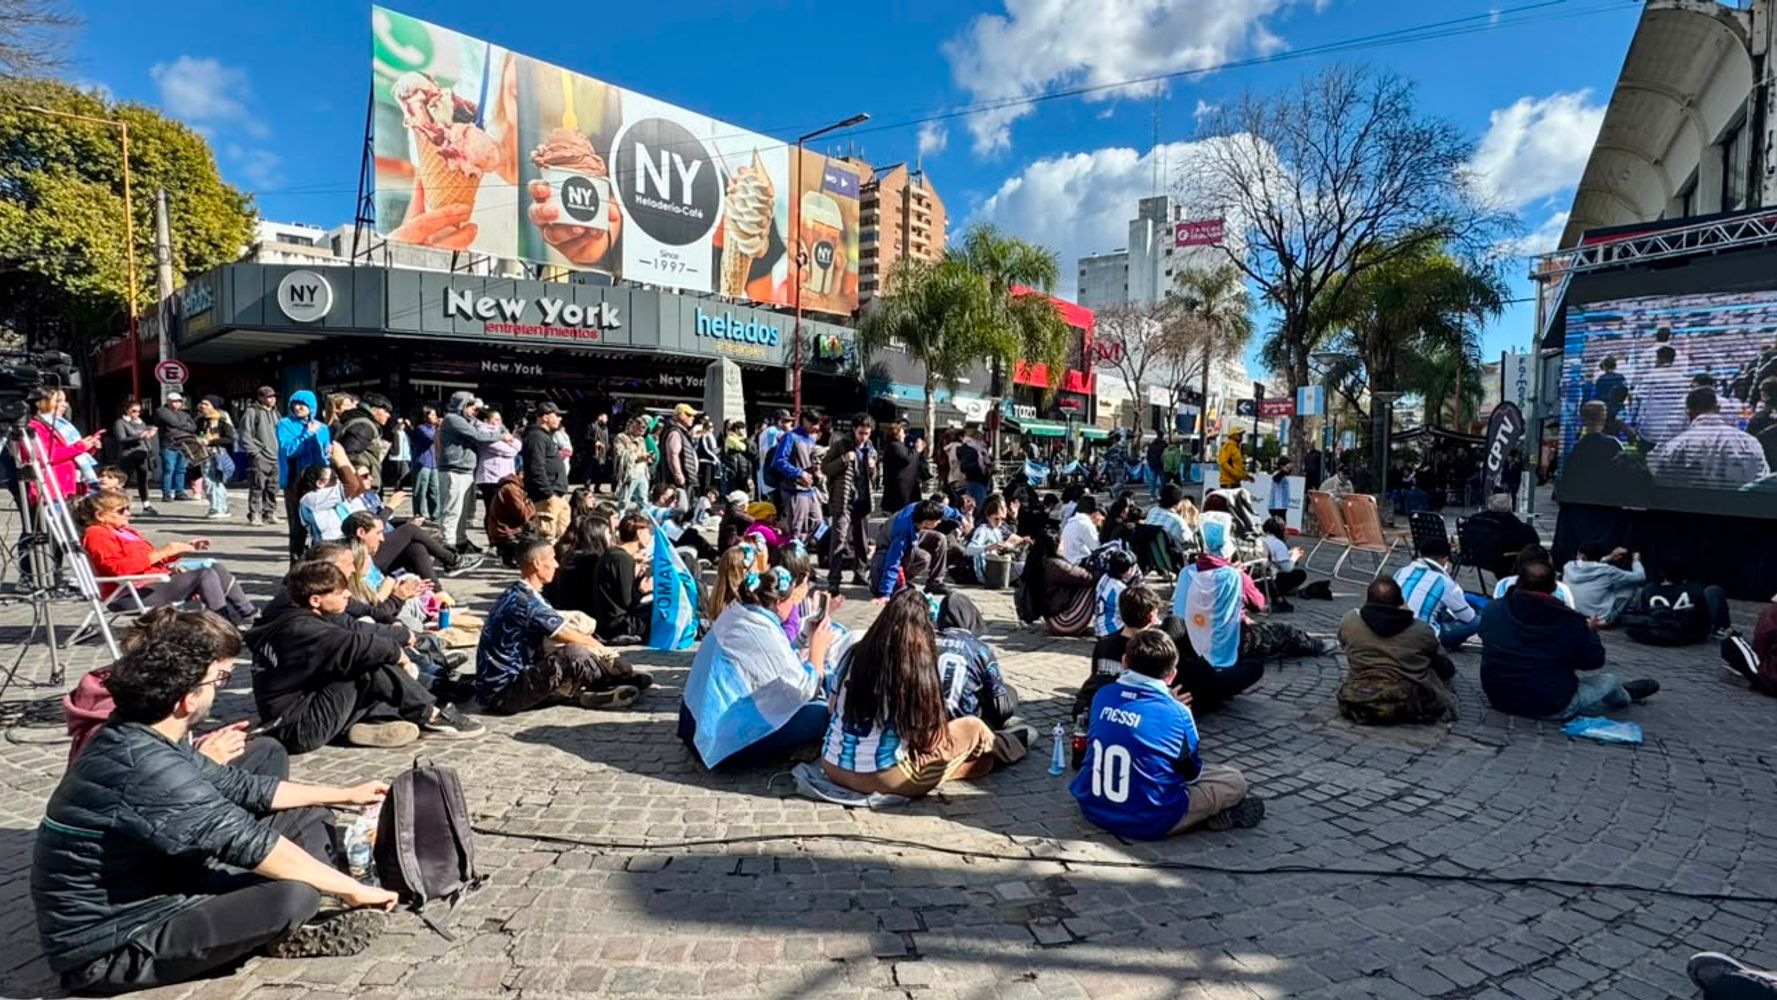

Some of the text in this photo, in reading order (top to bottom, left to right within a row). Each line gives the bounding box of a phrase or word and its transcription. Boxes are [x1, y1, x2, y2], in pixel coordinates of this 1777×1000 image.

[635, 142, 703, 206] NY
[568, 186, 592, 206] NY
[290, 284, 319, 303] NY
[444, 287, 621, 328] New York
[486, 323, 599, 340] entretenimientos
[696, 307, 780, 346] helados
[481, 360, 544, 376] New York
[659, 373, 707, 388] New Yor
[1487, 416, 1515, 472] CPTV
[1100, 706, 1142, 729] MESSI
[1091, 738, 1131, 803] 10
